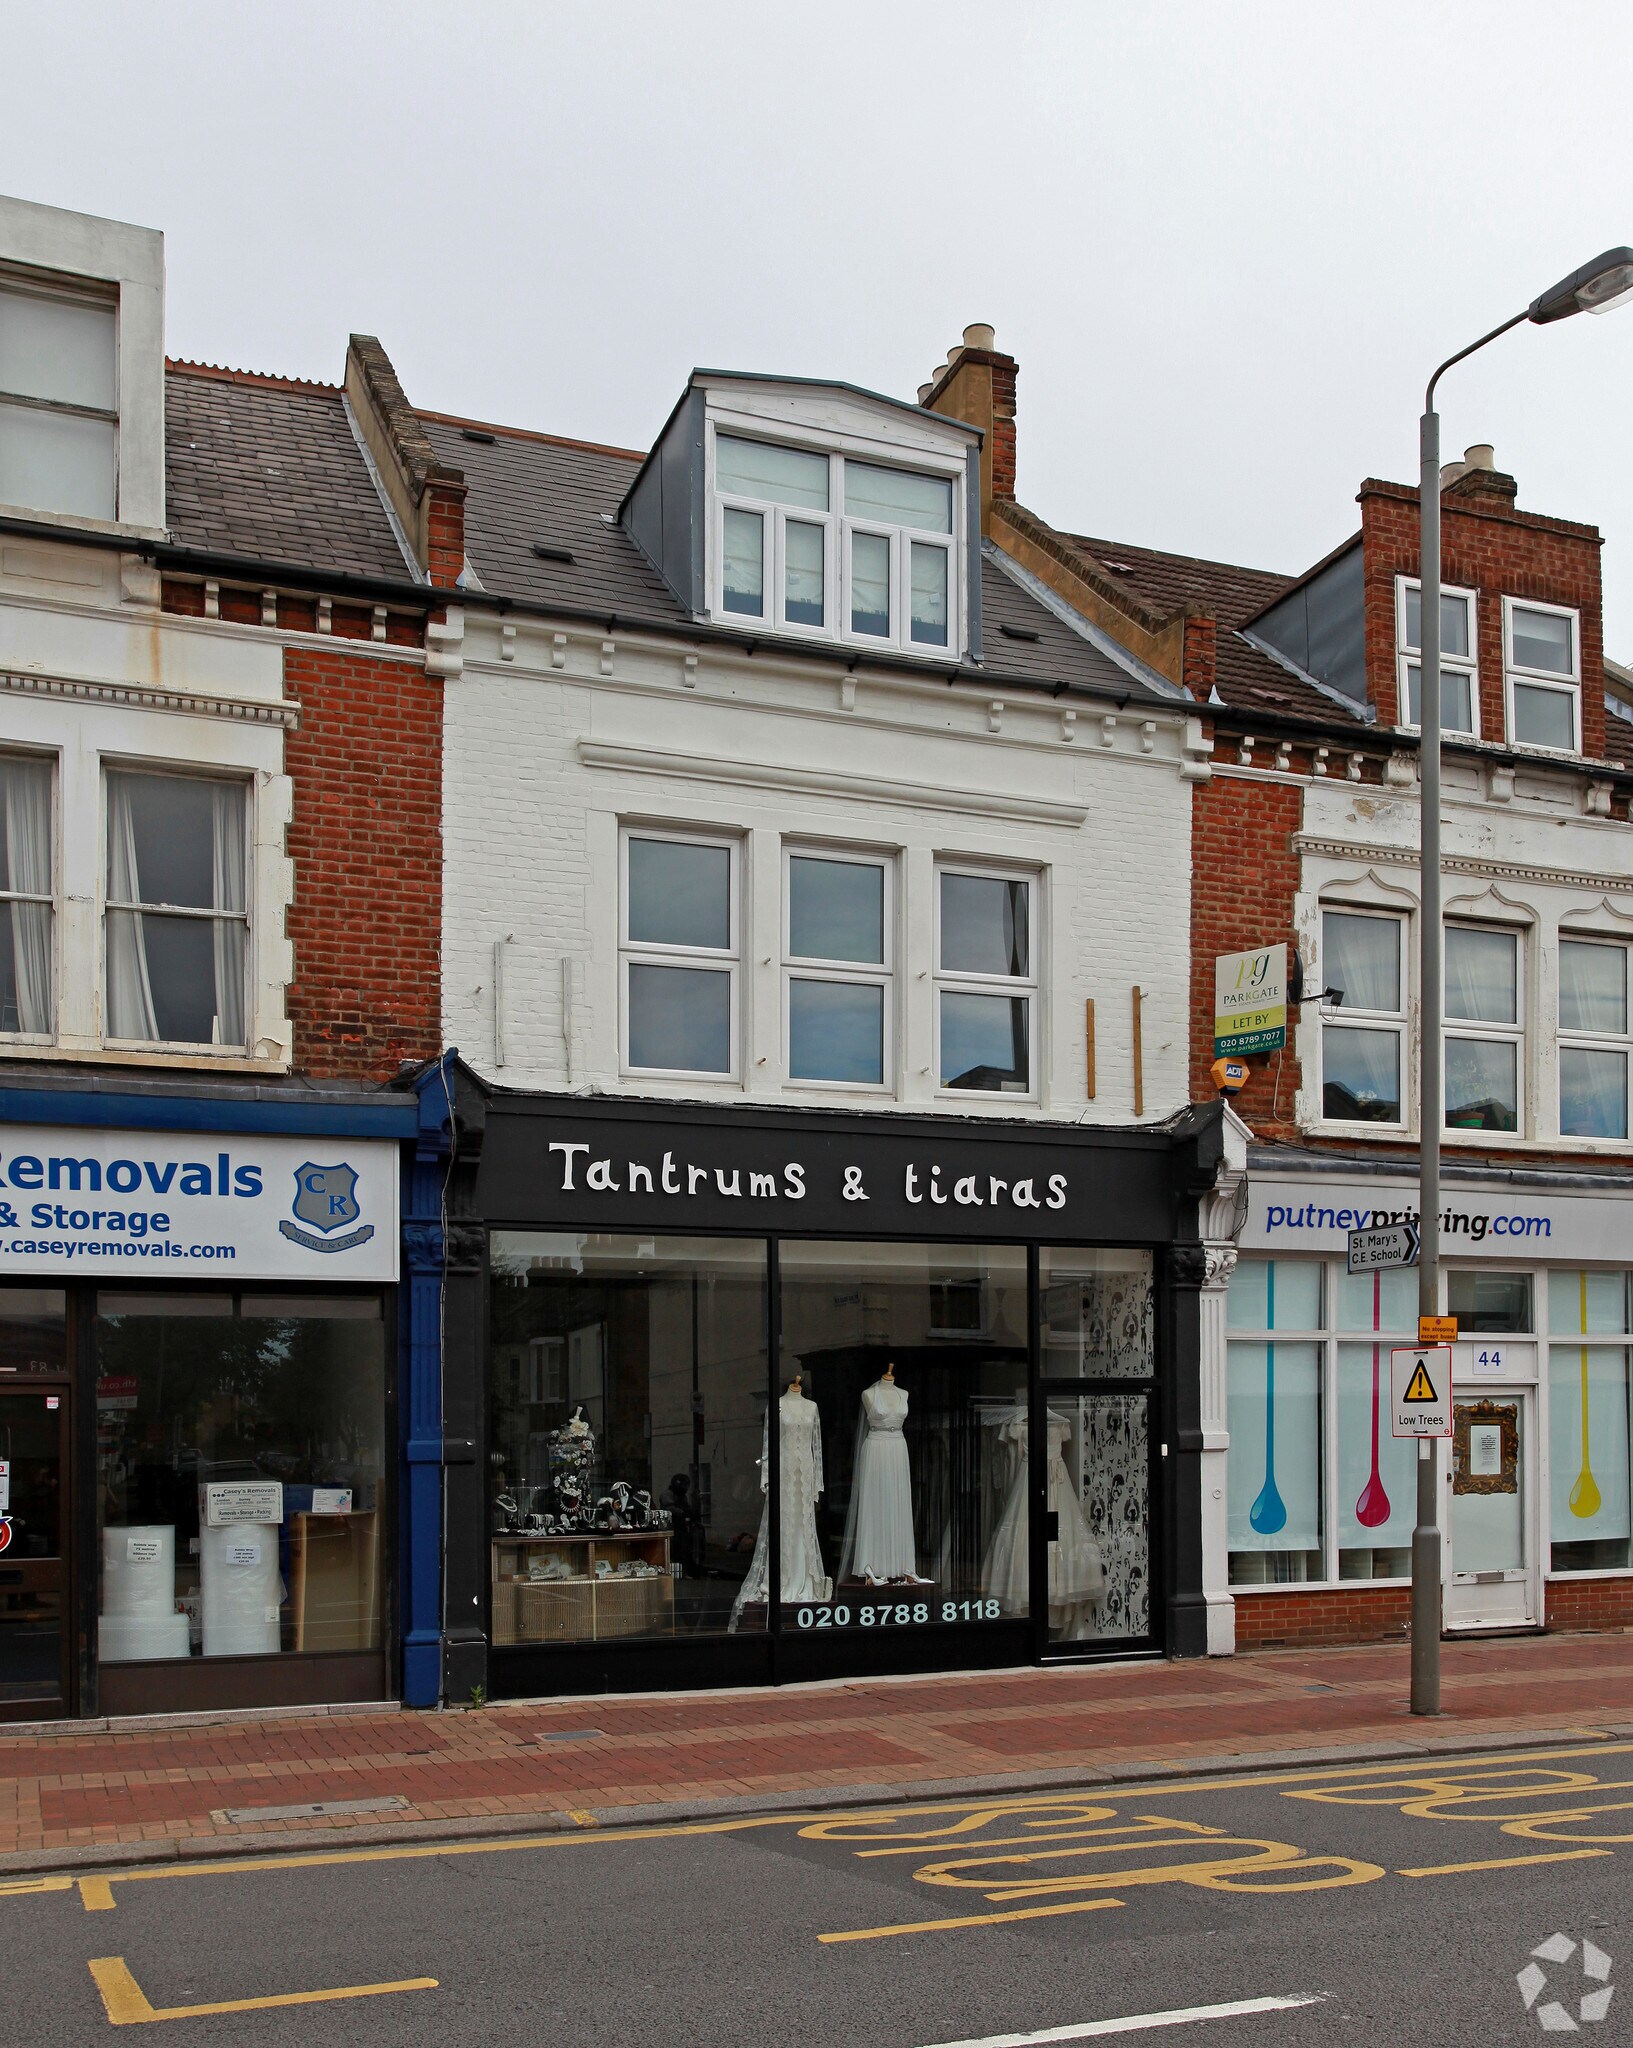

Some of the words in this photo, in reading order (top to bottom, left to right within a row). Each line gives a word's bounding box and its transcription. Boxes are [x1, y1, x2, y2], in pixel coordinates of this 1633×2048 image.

[1223, 986, 1279, 1004] PARKGATE
[1233, 1017, 1252, 1029] LET
[1255, 1014, 1269, 1025] BY
[1220, 1038, 1237, 1048] 020
[1239, 1035, 1259, 1045] 8789
[1262, 1031, 1280, 1041] 7077
[1220, 1040, 1280, 1054] www.parkgate.co.uk
[1226, 1066, 1243, 1077] ADT
[0, 1153, 263, 1197] emovals
[305, 1173, 326, 1194] C
[549, 1142, 806, 1199] Tantrums
[842, 1166, 870, 1200] &
[905, 1163, 1068, 1209] tiaras
[328, 1195, 349, 1215] R
[0, 1202, 21, 1228] &
[31, 1203, 170, 1238] Storage
[1266, 1203, 1551, 1241] putneypriing.com
[294, 1232, 326, 1248] SERVICE
[337, 1235, 360, 1248] CARE
[1352, 1237, 1366, 1249] St.
[1367, 1234, 1398, 1247] Mary's
[0, 1239, 236, 1259] .caseyremovals.com
[1352, 1252, 1369, 1264] C.E.
[1370, 1247, 1401, 1262] School
[1478, 1351, 1501, 1367] 44
[1398, 1414, 1416, 1425] Low
[1418, 1414, 1444, 1425] Trees
[797, 1605, 850, 1629] 020
[859, 1603, 929, 1626] 8788
[941, 1599, 1000, 1622] 8118
